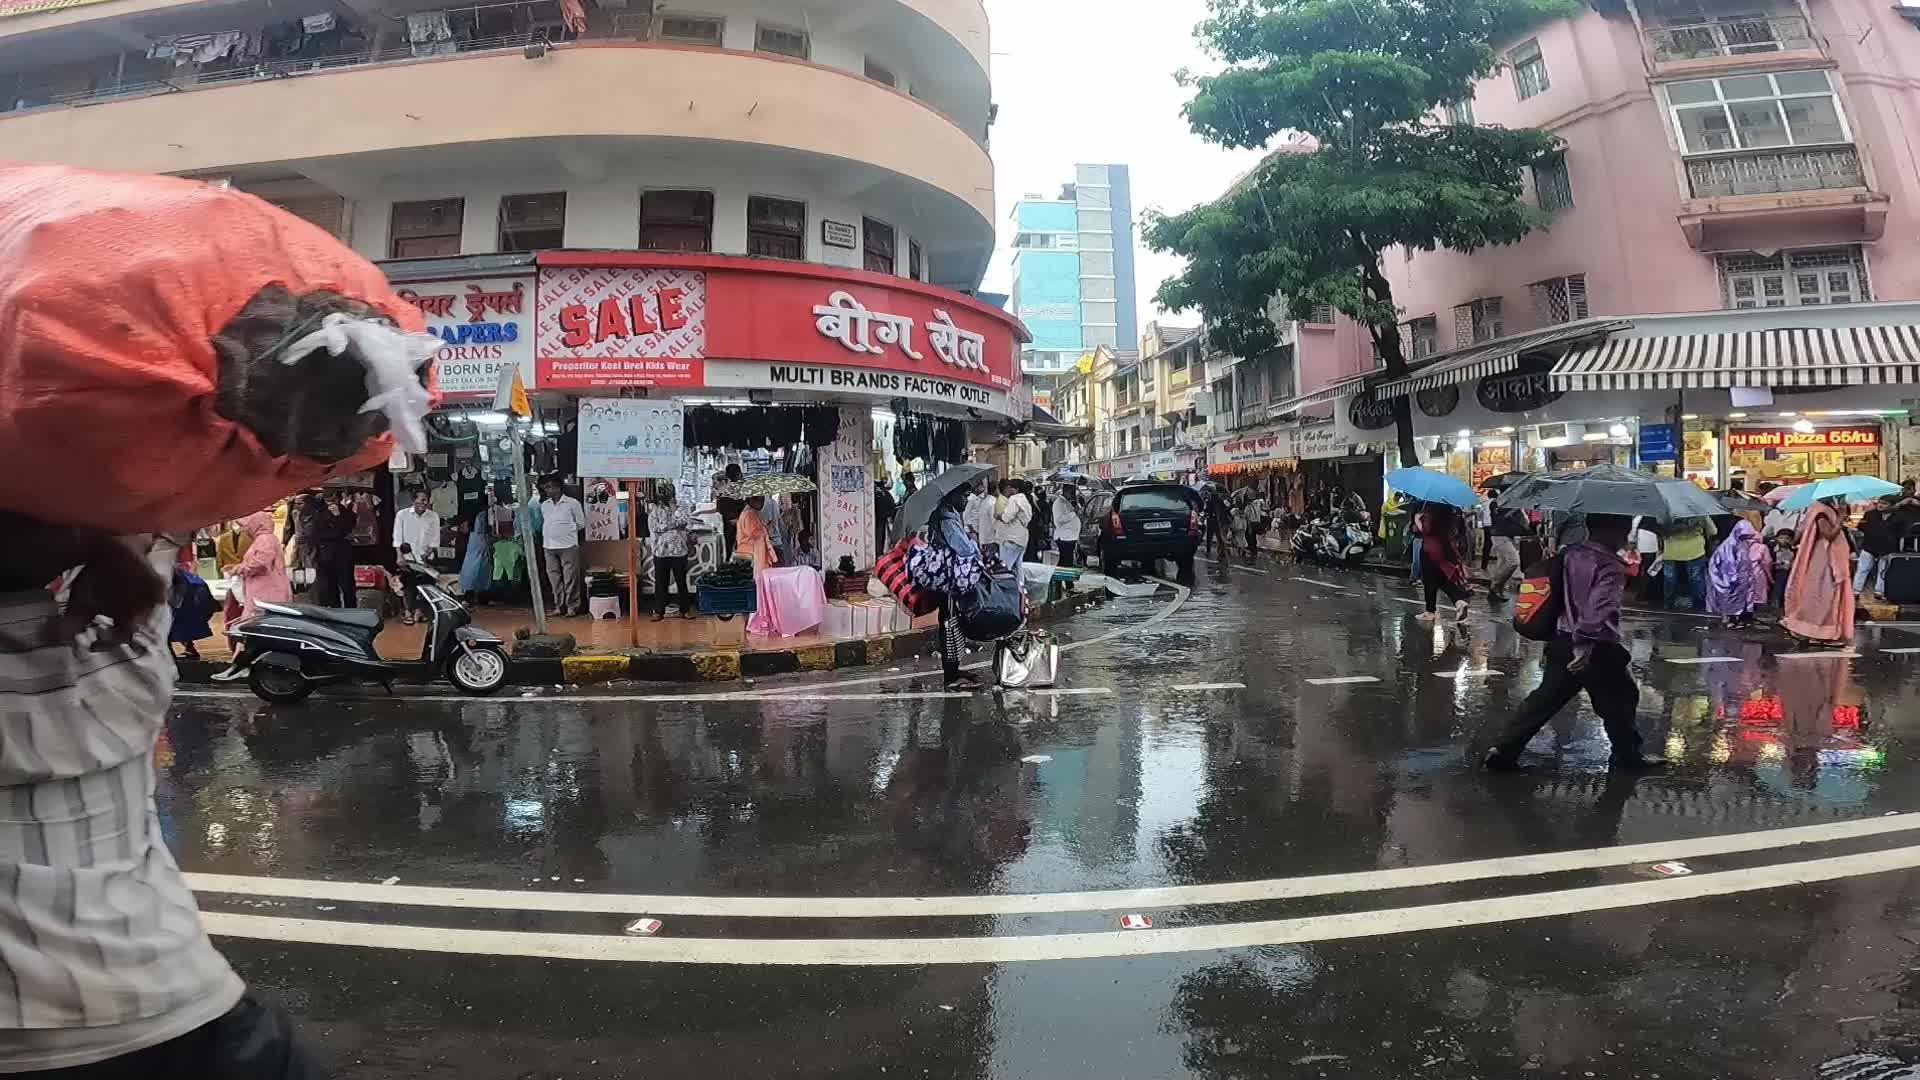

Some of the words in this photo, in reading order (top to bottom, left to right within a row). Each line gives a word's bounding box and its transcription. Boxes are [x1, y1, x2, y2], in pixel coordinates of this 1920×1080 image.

[559, 287, 689, 349] SALE
[812, 290, 924, 360] बीग
[925, 308, 990, 374] सेल
[438, 344, 503, 361] ORMS
[443, 363, 481, 376] BORN
[770, 366, 824, 384] MULTI
[831, 370, 900, 390] BRANDS
[904, 376, 957, 398] FACTORY
[960, 385, 991, 405] OUTLET
[1749, 432, 1780, 445] mini
[1784, 432, 1826, 446] pizza
[836, 499, 859, 514] SALE
[590, 518, 612, 530] SALE
[836, 517, 859, 532] SALE
[837, 534, 859, 547] SALE
